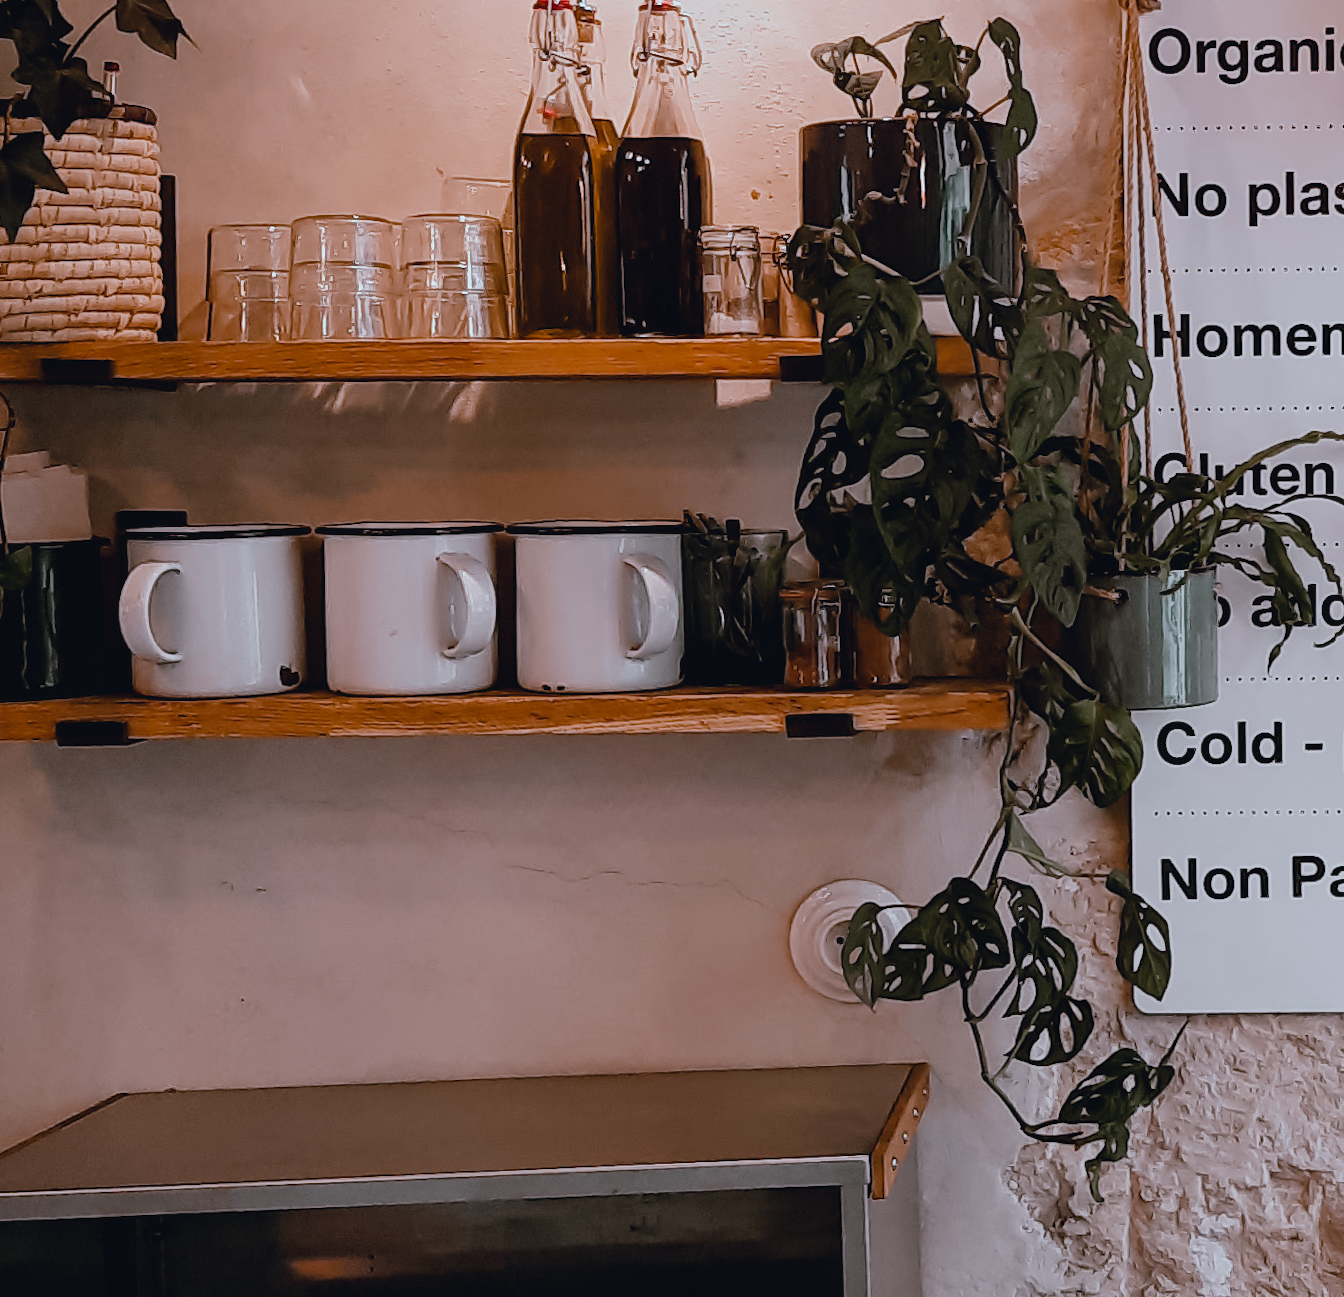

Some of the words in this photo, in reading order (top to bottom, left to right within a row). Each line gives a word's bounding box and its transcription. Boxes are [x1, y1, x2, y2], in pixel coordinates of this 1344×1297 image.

[1152, 173, 1227, 217] No
[1156, 720, 1283, 766] Cold
[1304, 742, 1324, 751] -
[1160, 857, 1270, 901] Non
